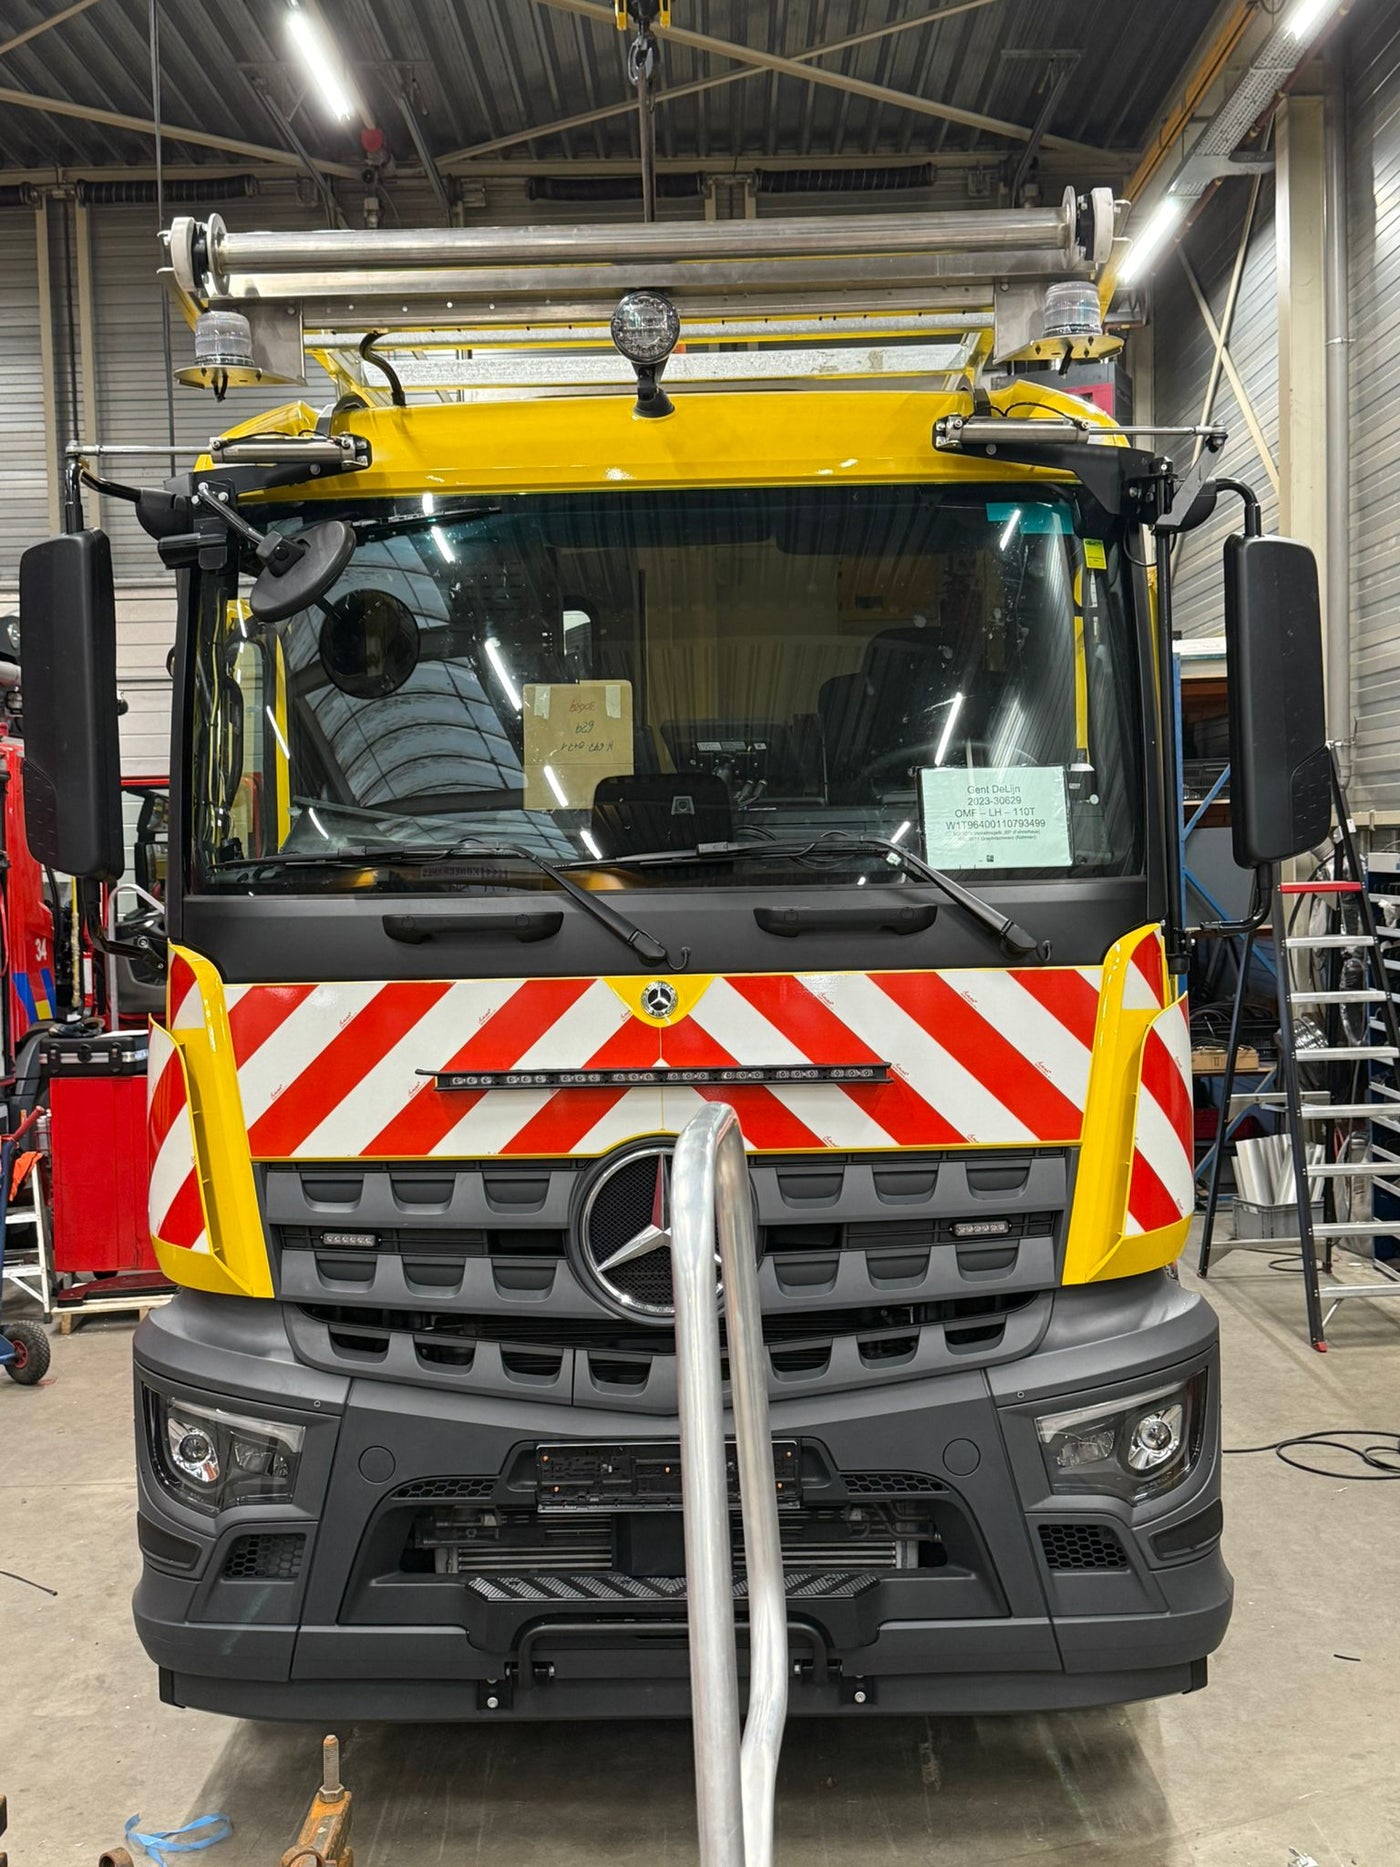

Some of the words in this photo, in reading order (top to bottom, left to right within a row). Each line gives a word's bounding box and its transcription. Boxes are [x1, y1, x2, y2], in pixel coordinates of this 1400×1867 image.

[967, 785, 989, 794] Gent
[992, 785, 1021, 795] DeLijn
[967, 796, 1022, 806] 2023-30629
[954, 808, 977, 818] OMF
[988, 807, 1002, 817] LH
[1013, 807, 1036, 816] 110T
[35, 938, 47, 961] 34
